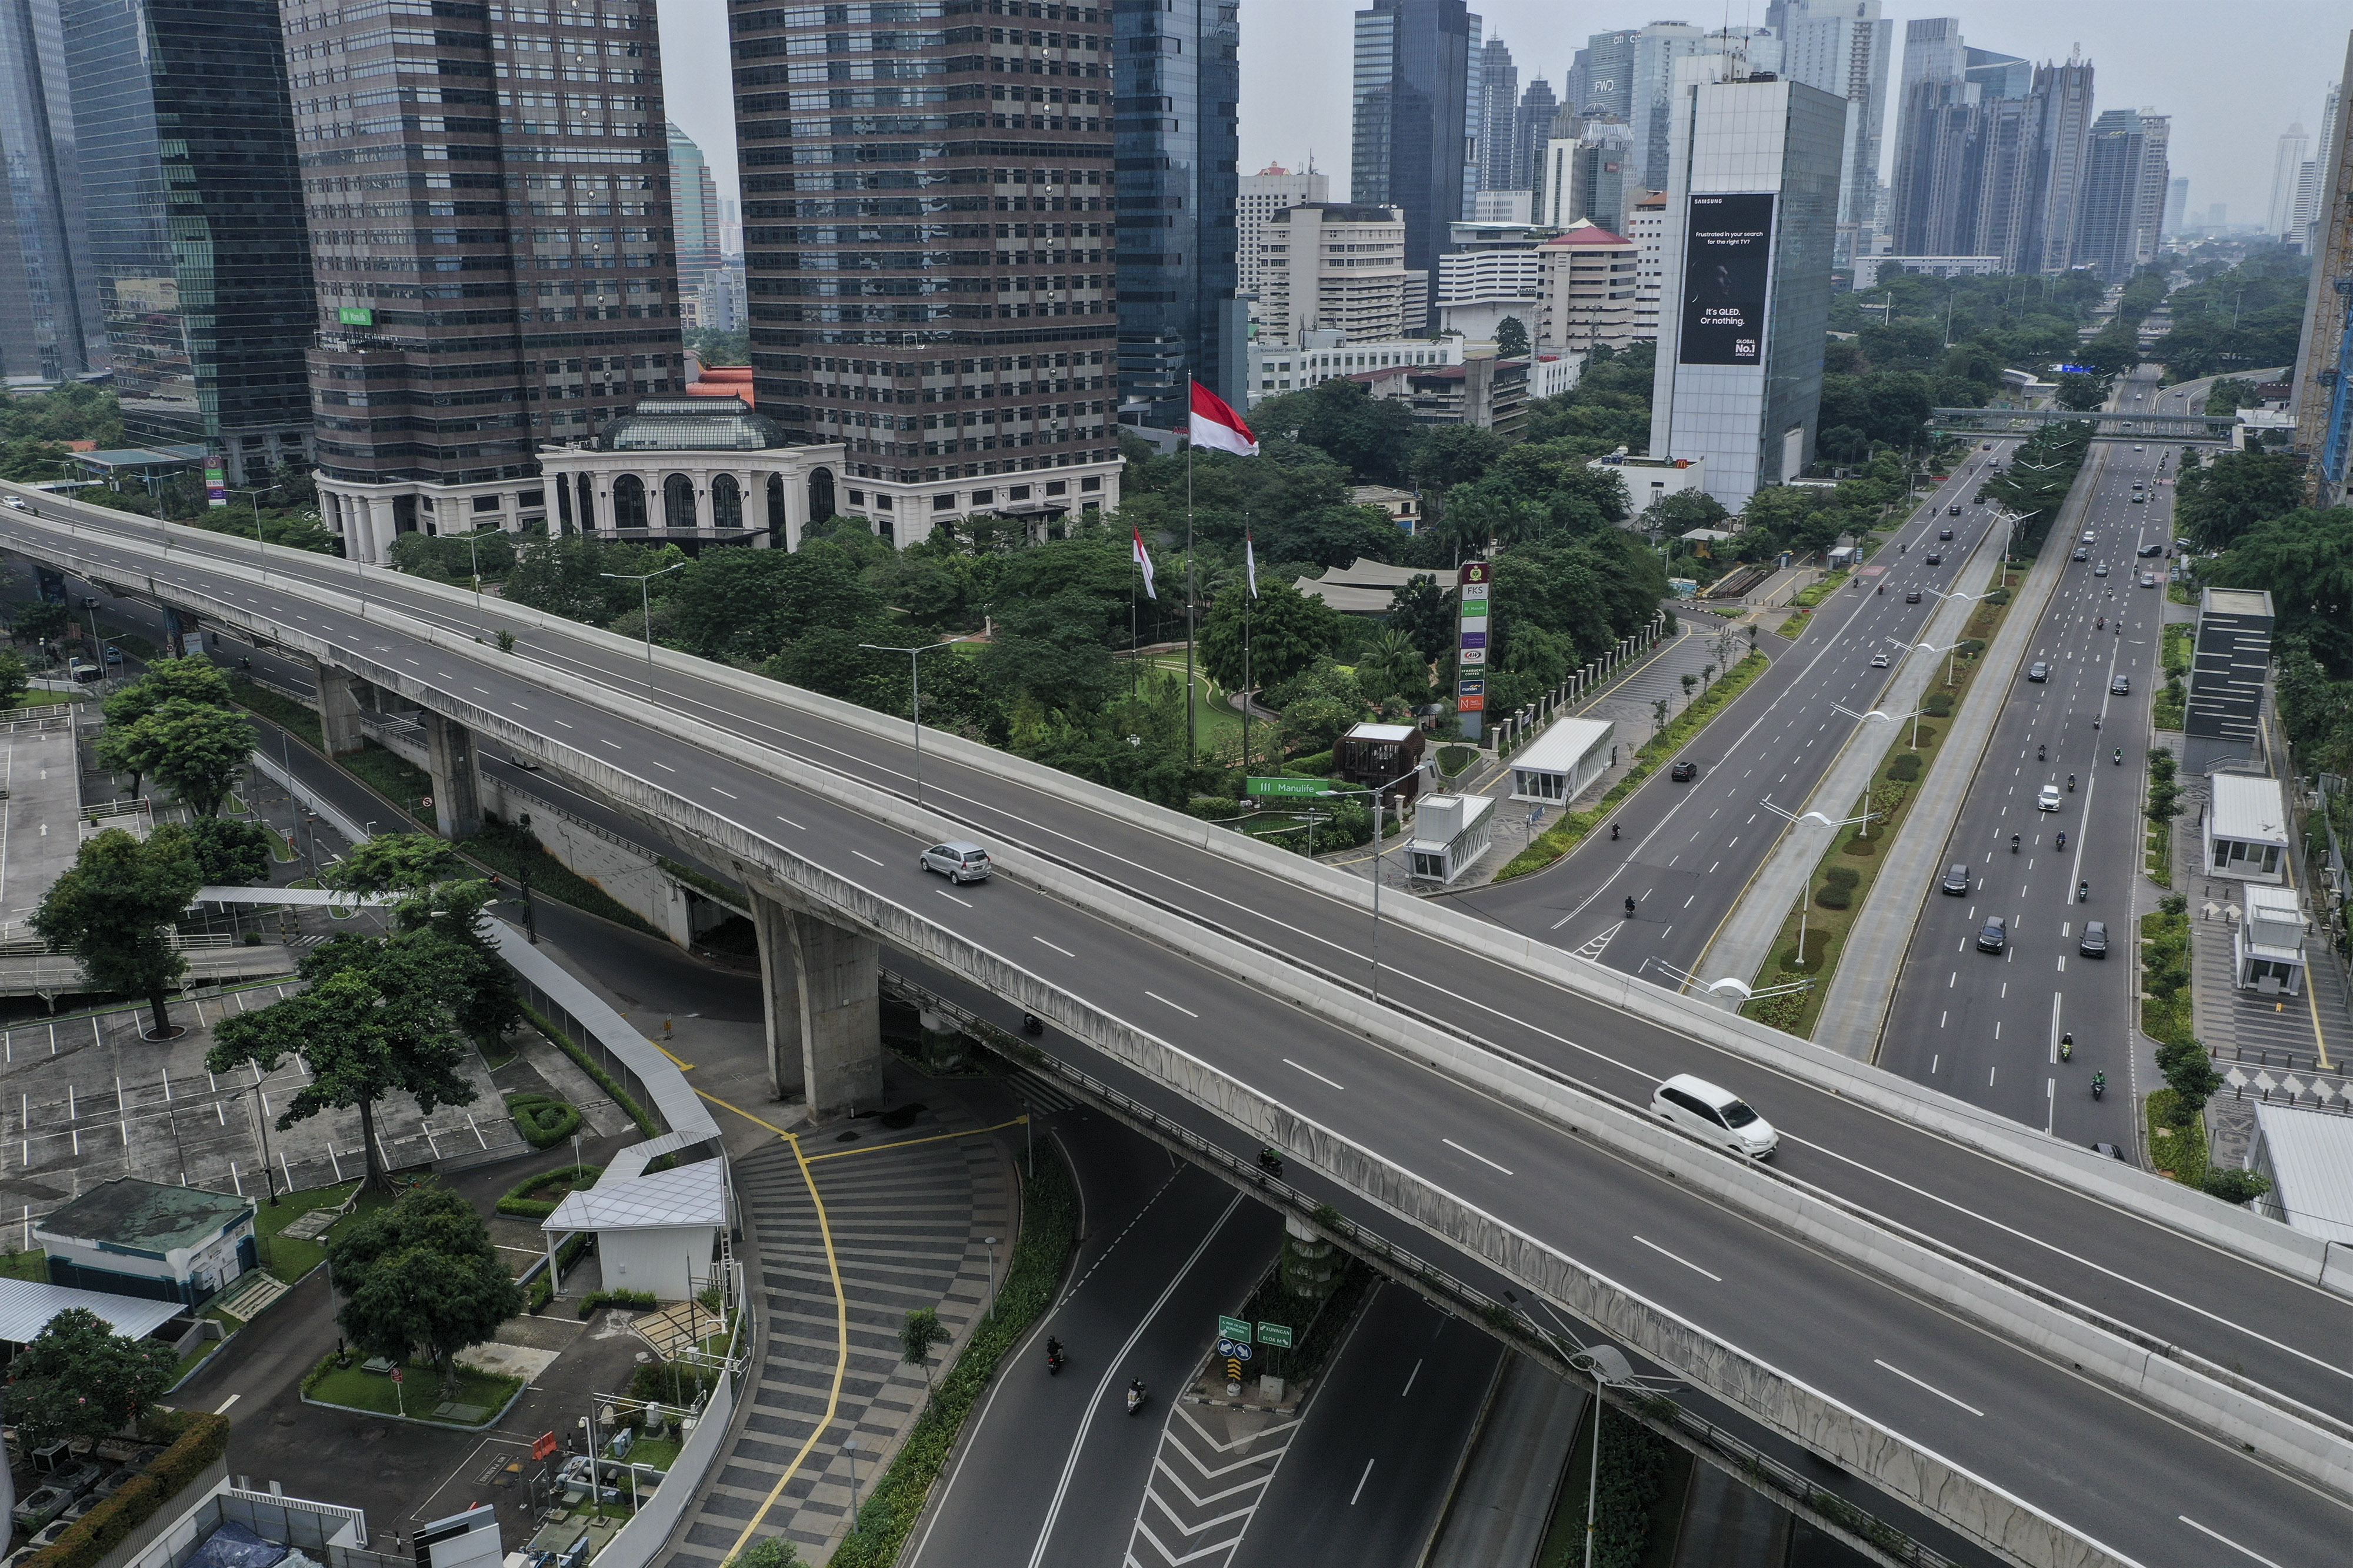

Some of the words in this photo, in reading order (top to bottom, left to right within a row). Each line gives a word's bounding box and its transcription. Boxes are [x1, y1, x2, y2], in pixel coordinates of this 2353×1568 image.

[1595, 80, 1614, 92] FWD
[1712, 317, 1745, 326] nothing.
[1735, 344, 1755, 353] No.1
[571, 461, 645, 469] SAMPOERNA
[729, 461, 769, 469] SQUARE
[1278, 784, 1314, 793] Manulife
[1225, 1326, 1244, 1334] KUNINGAN
[1266, 1327, 1290, 1335] KUNINGAN
